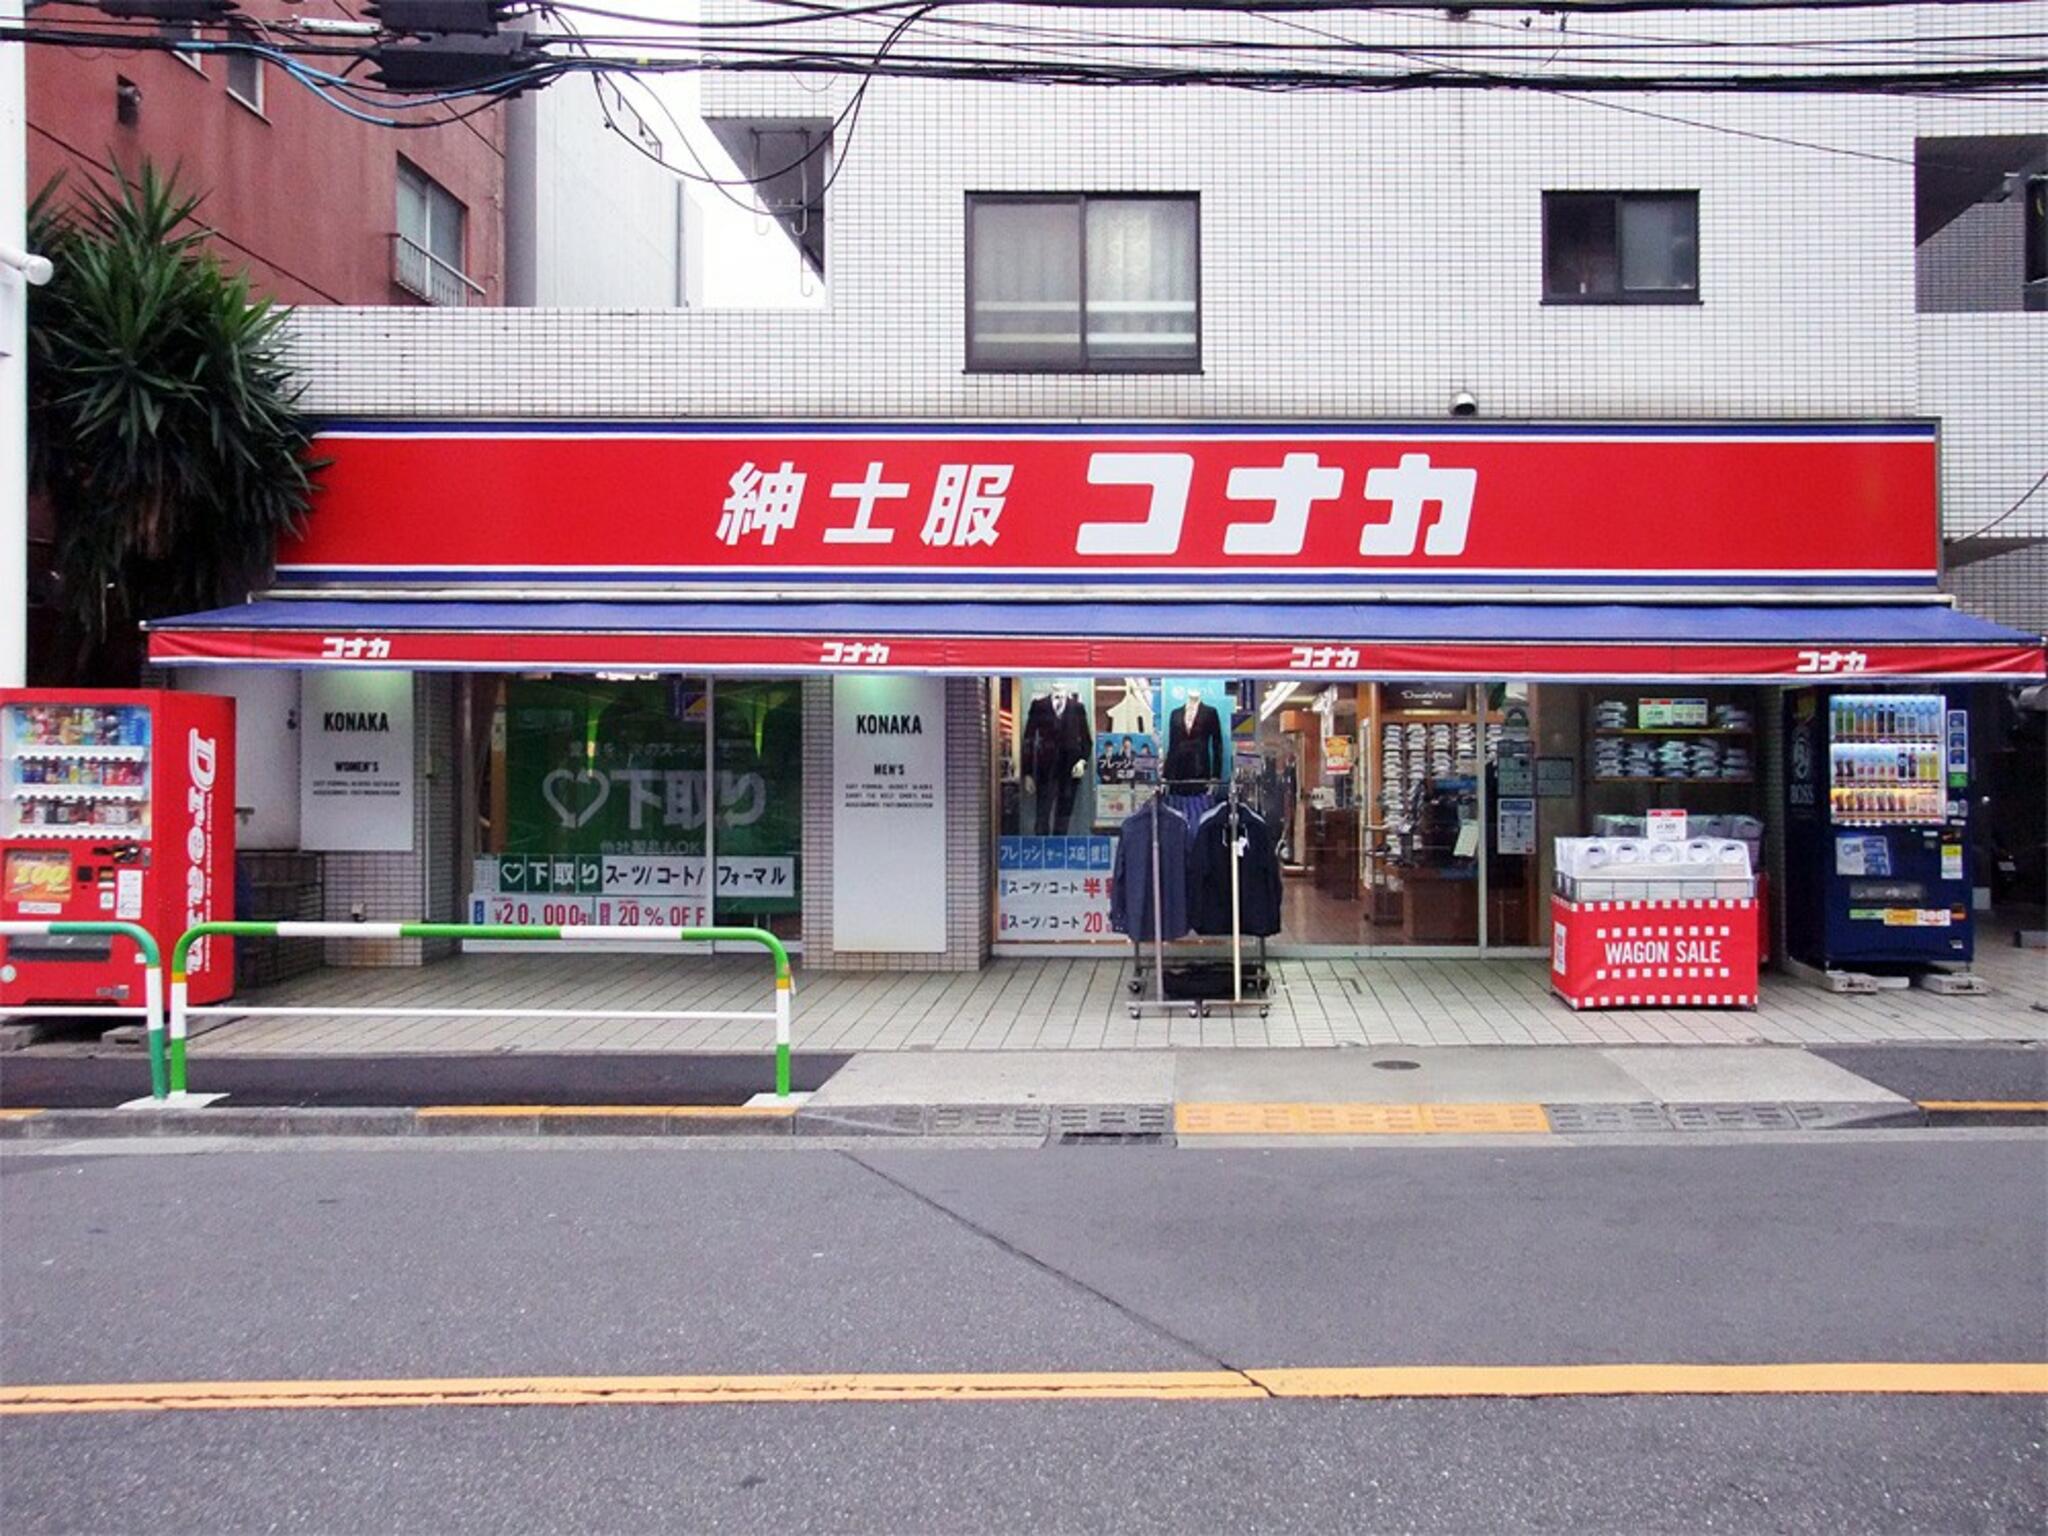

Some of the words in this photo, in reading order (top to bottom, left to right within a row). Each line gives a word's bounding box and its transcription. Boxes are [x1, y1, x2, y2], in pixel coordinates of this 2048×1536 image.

[715, 461, 1014, 546] 紳士服
[1075, 452, 1478, 557] コナカ
[321, 637, 391, 658] コナカ
[820, 642, 890, 664] コナカ
[1290, 646, 1360, 668] コナカ
[1796, 651, 1867, 672] コナカ
[324, 712, 389, 732] KONAKA
[857, 715, 922, 734] KONAKA
[874, 764, 904, 775] MEN'S
[610, 769, 766, 831] 下取り
[529, 862, 599, 885] 下取り
[1604, 941, 1669, 965] WAGON
[1674, 940, 1722, 963] SALE
